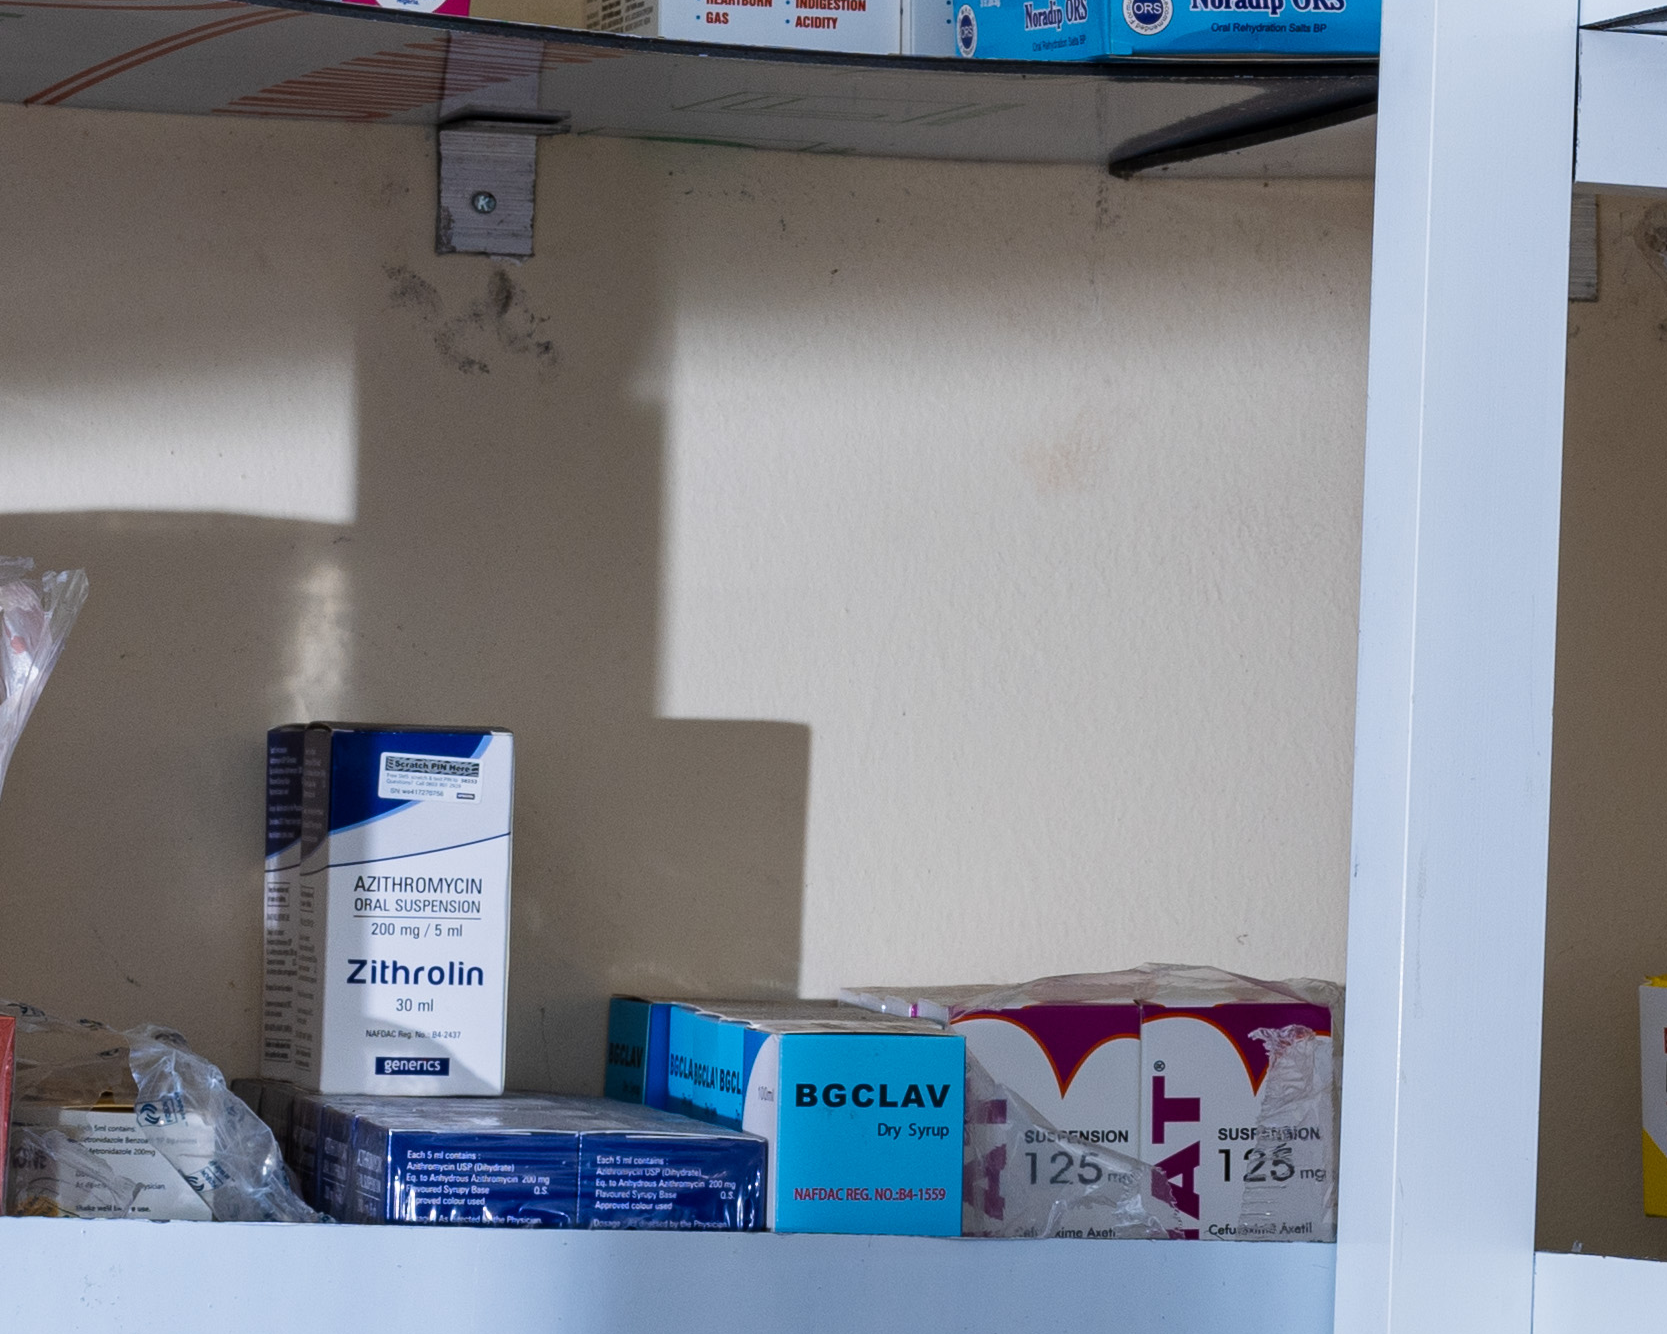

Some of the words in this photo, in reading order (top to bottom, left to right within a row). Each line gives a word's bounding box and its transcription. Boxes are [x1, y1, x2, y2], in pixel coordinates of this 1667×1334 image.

[705, 11, 729, 25] GAS
[795, 15, 838, 30] ACIDITY
[353, 875, 482, 895] AZITHROMYCIN
[354, 897, 391, 914] ORAL
[395, 898, 481, 914] SUSPENSION
[347, 957, 484, 987] Zithrolin
[396, 997, 414, 1012] 30
[418, 996, 433, 1012] ml
[383, 1057, 441, 1074] generics
[795, 1081, 951, 1110] BGCLAV
[876, 1121, 904, 1141] Dry
[908, 1123, 951, 1141] Syrup
[1024, 1127, 1130, 1144] SUSPENSION
[1024, 1149, 1104, 1187] 125
